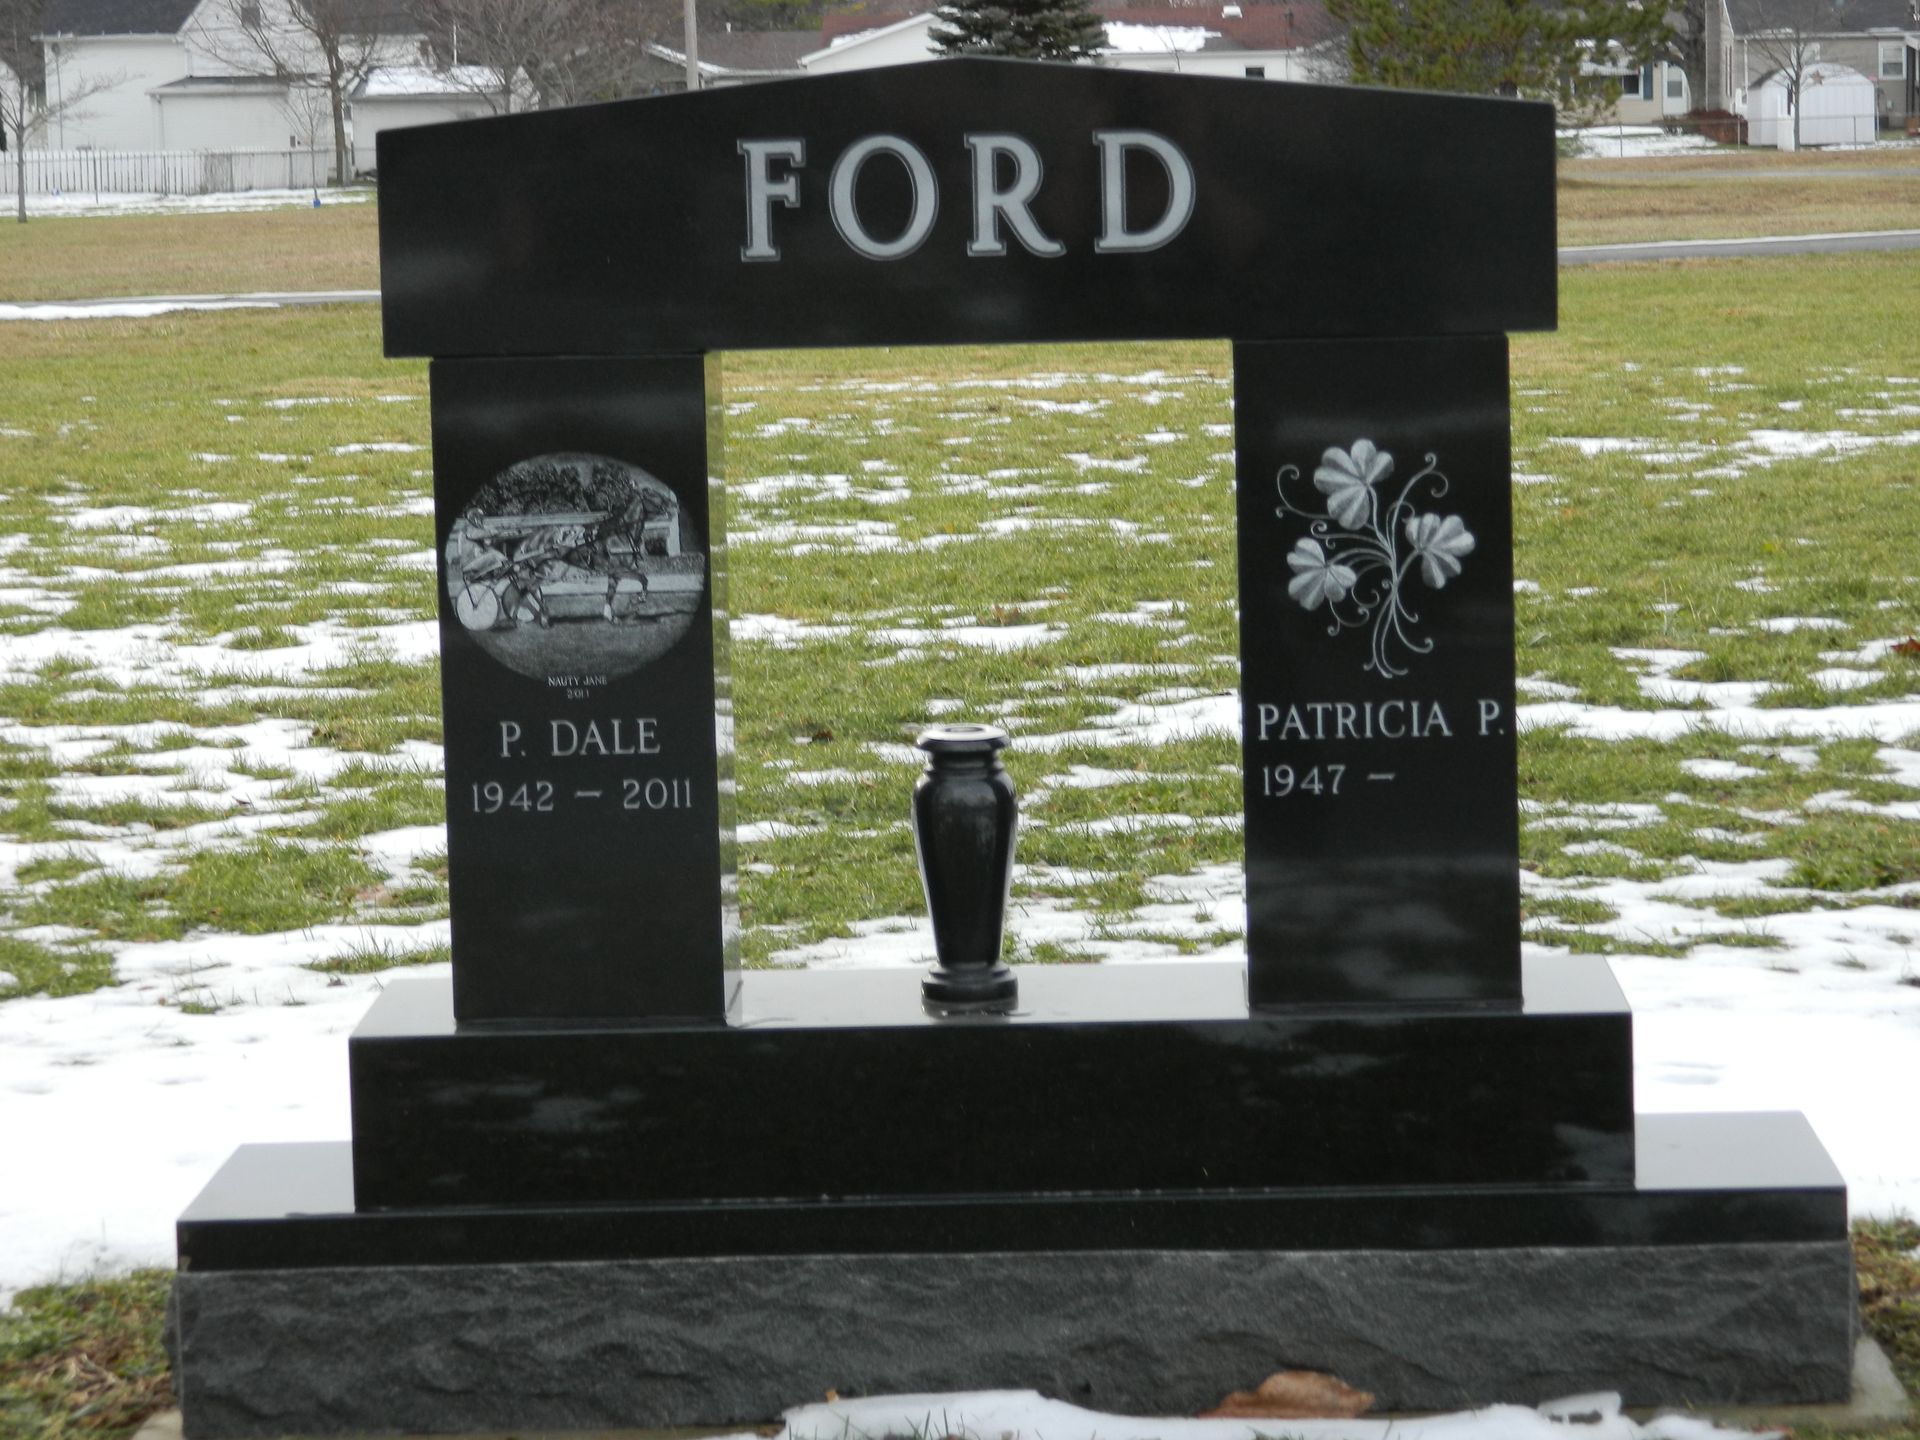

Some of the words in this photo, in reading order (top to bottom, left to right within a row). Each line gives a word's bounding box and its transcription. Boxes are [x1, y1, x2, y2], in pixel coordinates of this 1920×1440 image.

[736, 128, 1197, 263] FORD
[583, 674, 608, 687] JANE
[500, 720, 526, 758] P.
[550, 718, 662, 757] DALE
[1257, 700, 1453, 741] PATRICIA
[1477, 698, 1505, 736] P.
[471, 780, 555, 814] 1942
[622, 777, 693, 811] 2011
[1262, 763, 1347, 797] 1947
